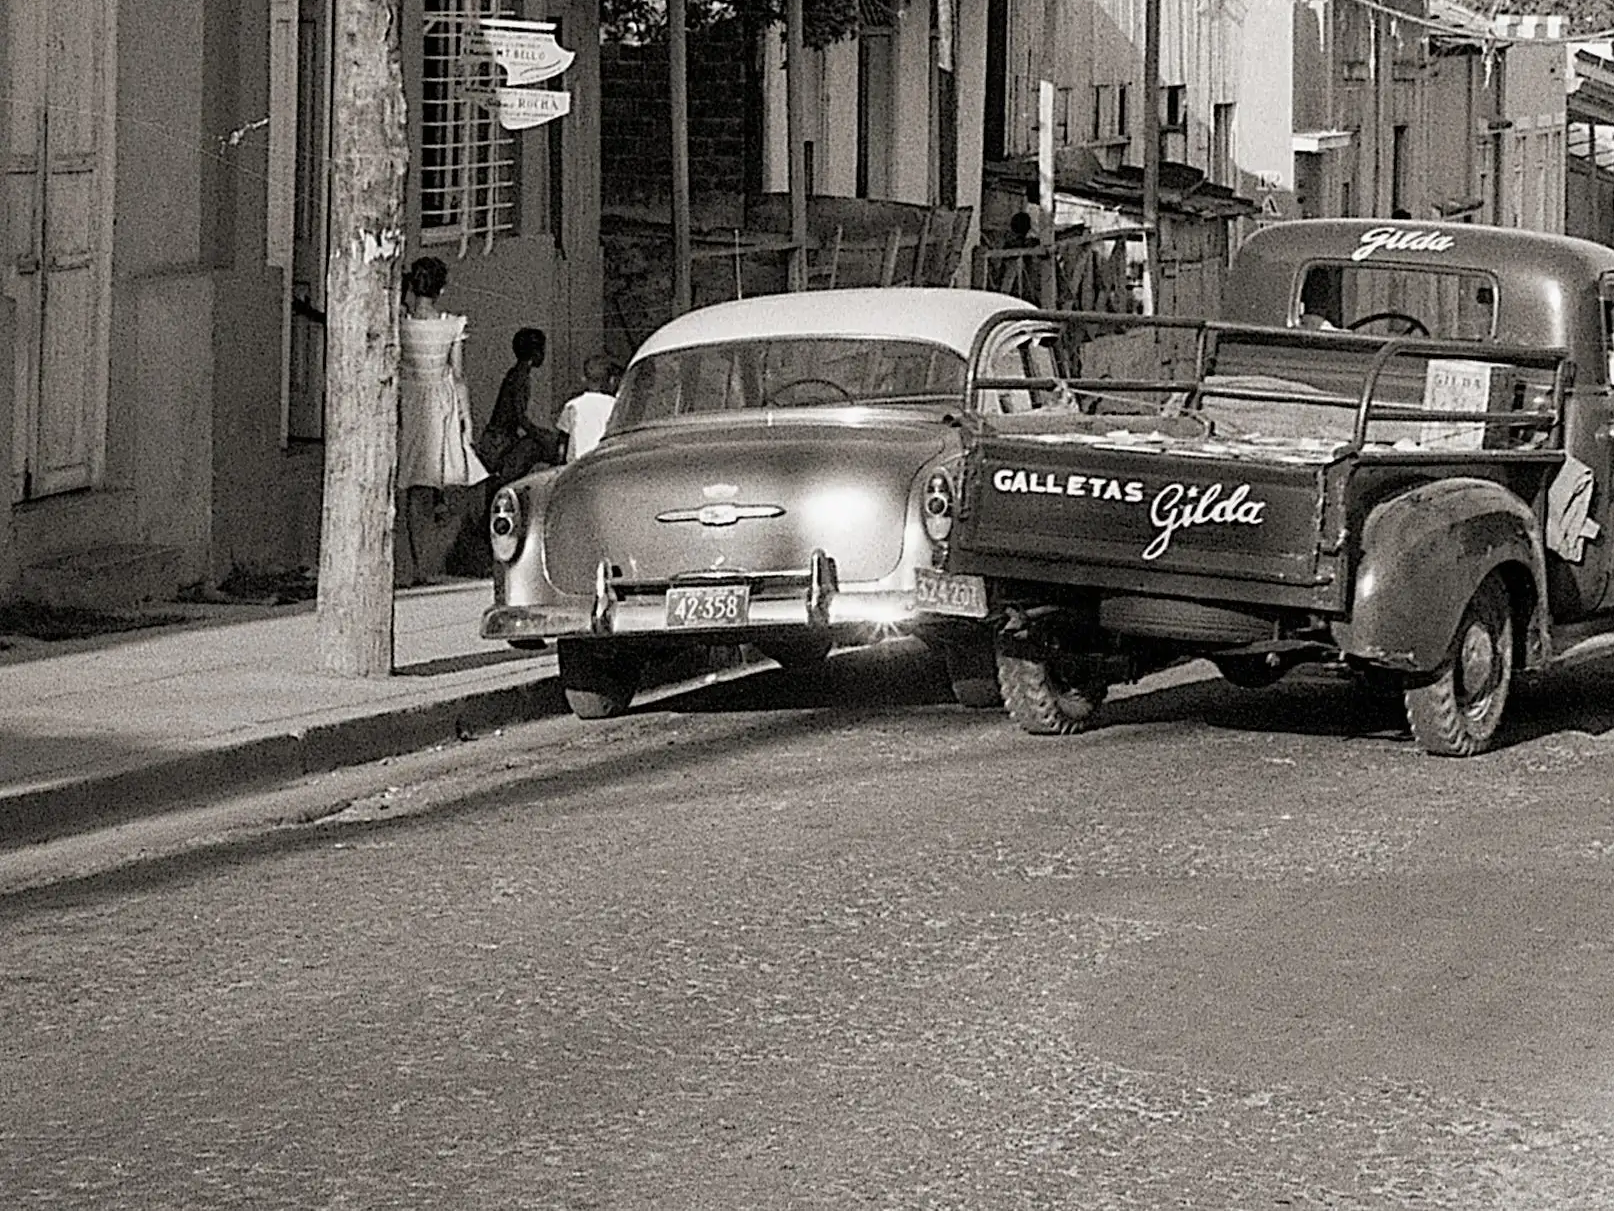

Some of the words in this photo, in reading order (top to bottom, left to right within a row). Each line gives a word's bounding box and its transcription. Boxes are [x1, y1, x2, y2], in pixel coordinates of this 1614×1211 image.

[514, 49, 546, 61] BELLO
[517, 97, 559, 110] ROCHA
[1351, 227, 1454, 261] Gilda
[993, 469, 1144, 502] GALLETAS
[1142, 483, 1266, 559] Gilda
